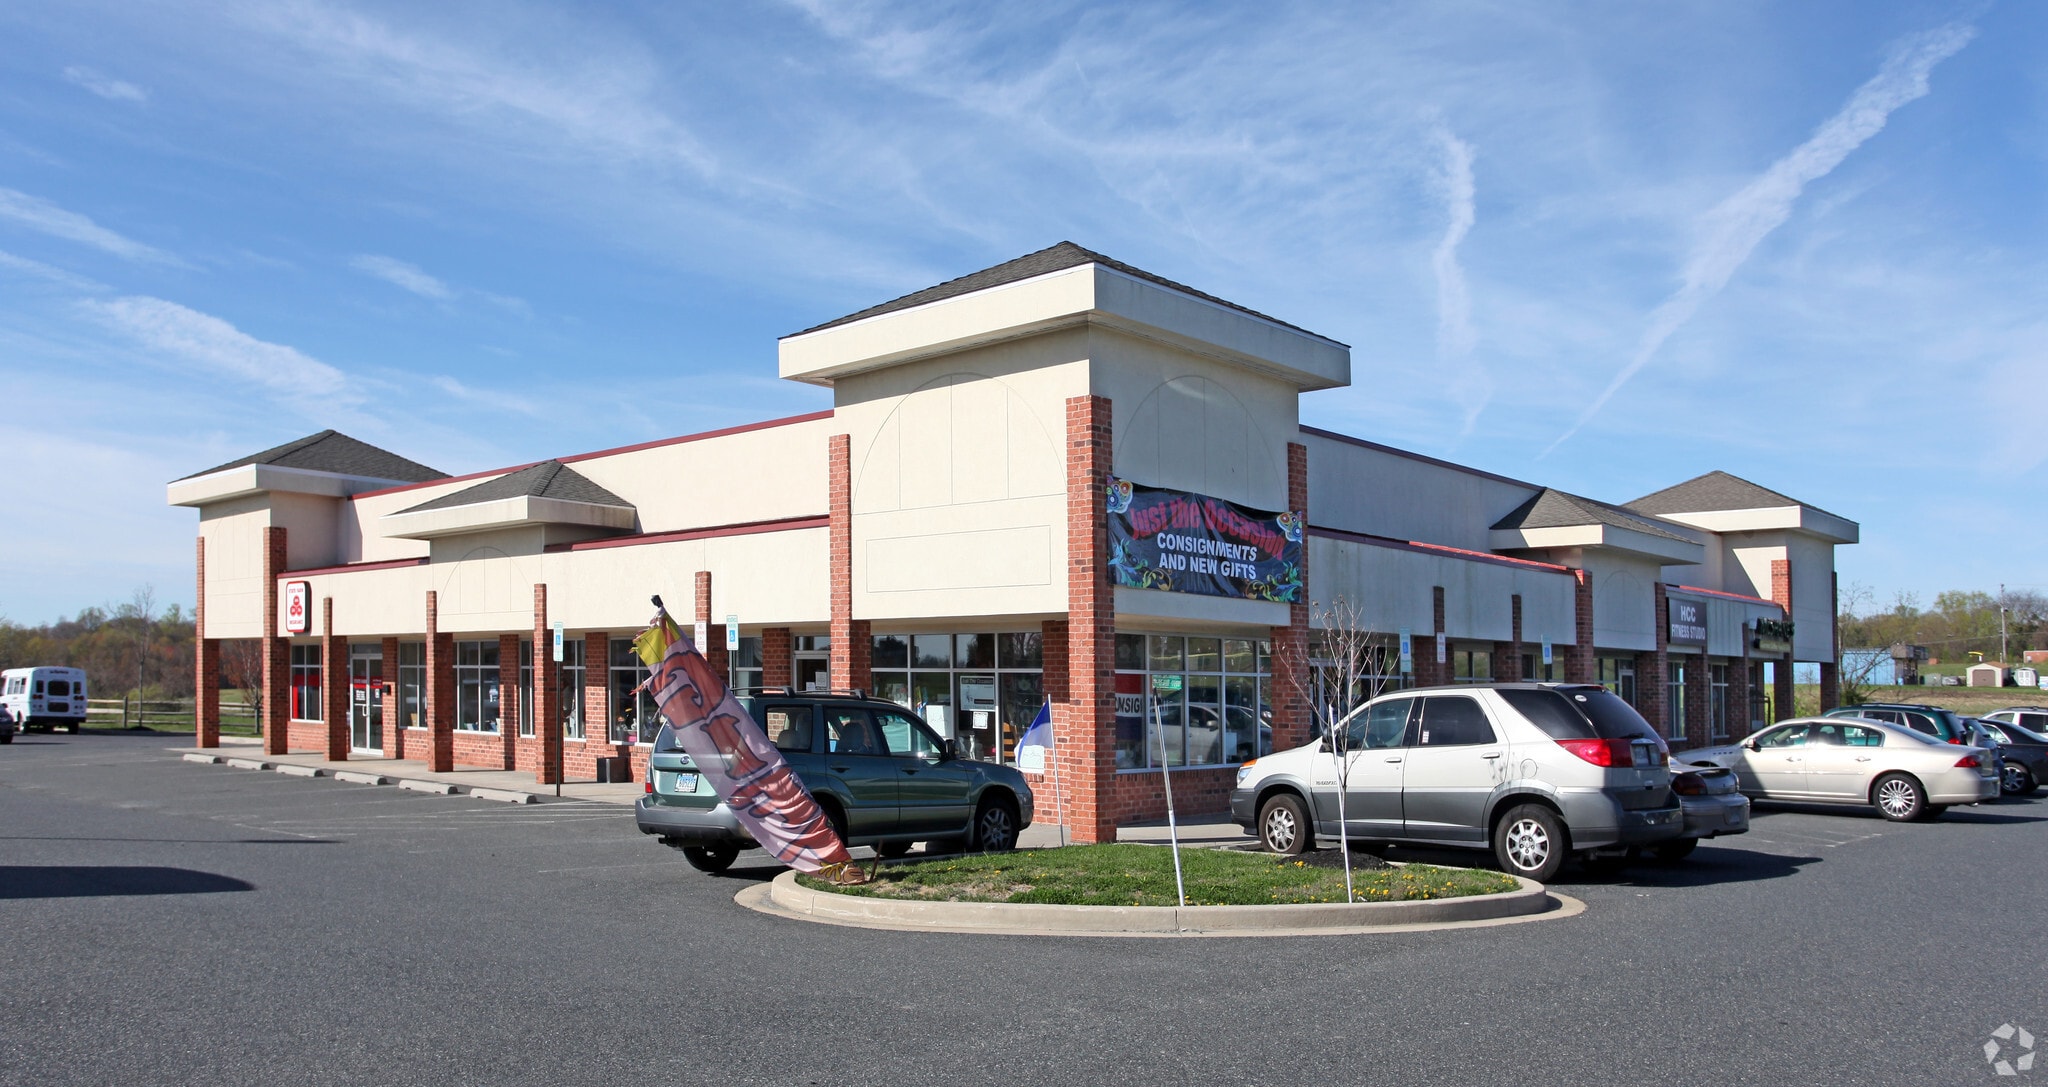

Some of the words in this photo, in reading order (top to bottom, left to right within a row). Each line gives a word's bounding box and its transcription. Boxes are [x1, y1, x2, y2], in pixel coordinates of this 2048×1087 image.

[1130, 502, 1168, 540] Just
[1170, 498, 1200, 529] the
[1204, 500, 1285, 560] Occasion
[1157, 532, 1257, 562] CONSIGNMENTS
[1159, 553, 1186, 571] AND
[1190, 557, 1217, 575] NEW
[1220, 562, 1257, 580] GIFTS
[1680, 605, 1696, 622] HCC
[1671, 623, 1690, 639] FITNESS
[1690, 625, 1706, 640] STUDIO
